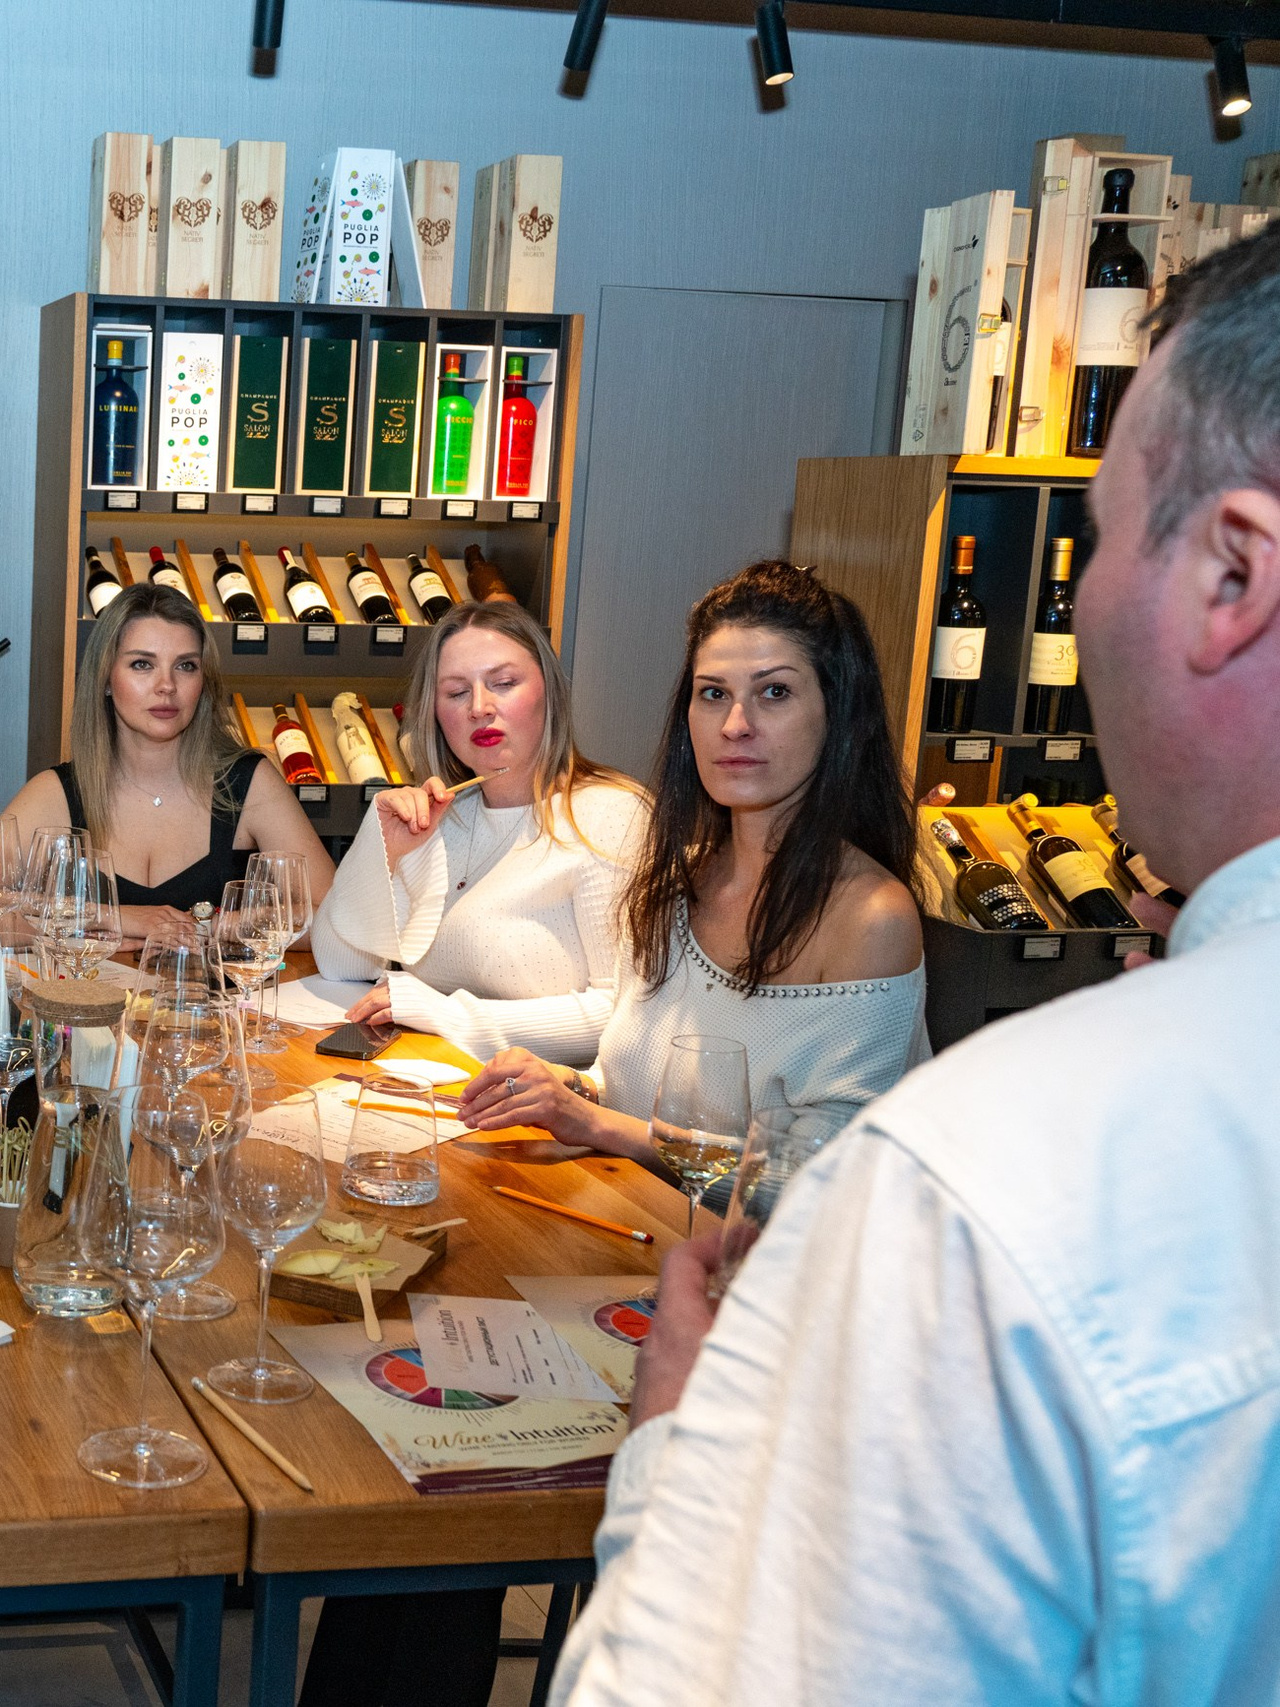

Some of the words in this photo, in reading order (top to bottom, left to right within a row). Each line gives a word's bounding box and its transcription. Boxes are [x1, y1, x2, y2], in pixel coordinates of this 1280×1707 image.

[303, 226, 321, 236] PUGLIA
[343, 223, 379, 232] PUGLIA
[300, 235, 320, 250] POP
[342, 231, 379, 245] POP
[171, 407, 208, 415] PUGLIA
[247, 401, 269, 422] S
[316, 403, 338, 425] S
[384, 406, 406, 427] S
[171, 416, 208, 428] POP
[243, 424, 271, 433] SALON
[313, 426, 340, 435] SALON
[381, 428, 408, 437] SALON
[951, 632, 977, 669] 6
[1054, 644, 1076, 661] 30
[437, 1309, 460, 1342] Intuition
[414, 1430, 494, 1449] Wine
[509, 1423, 615, 1442] Intuition
